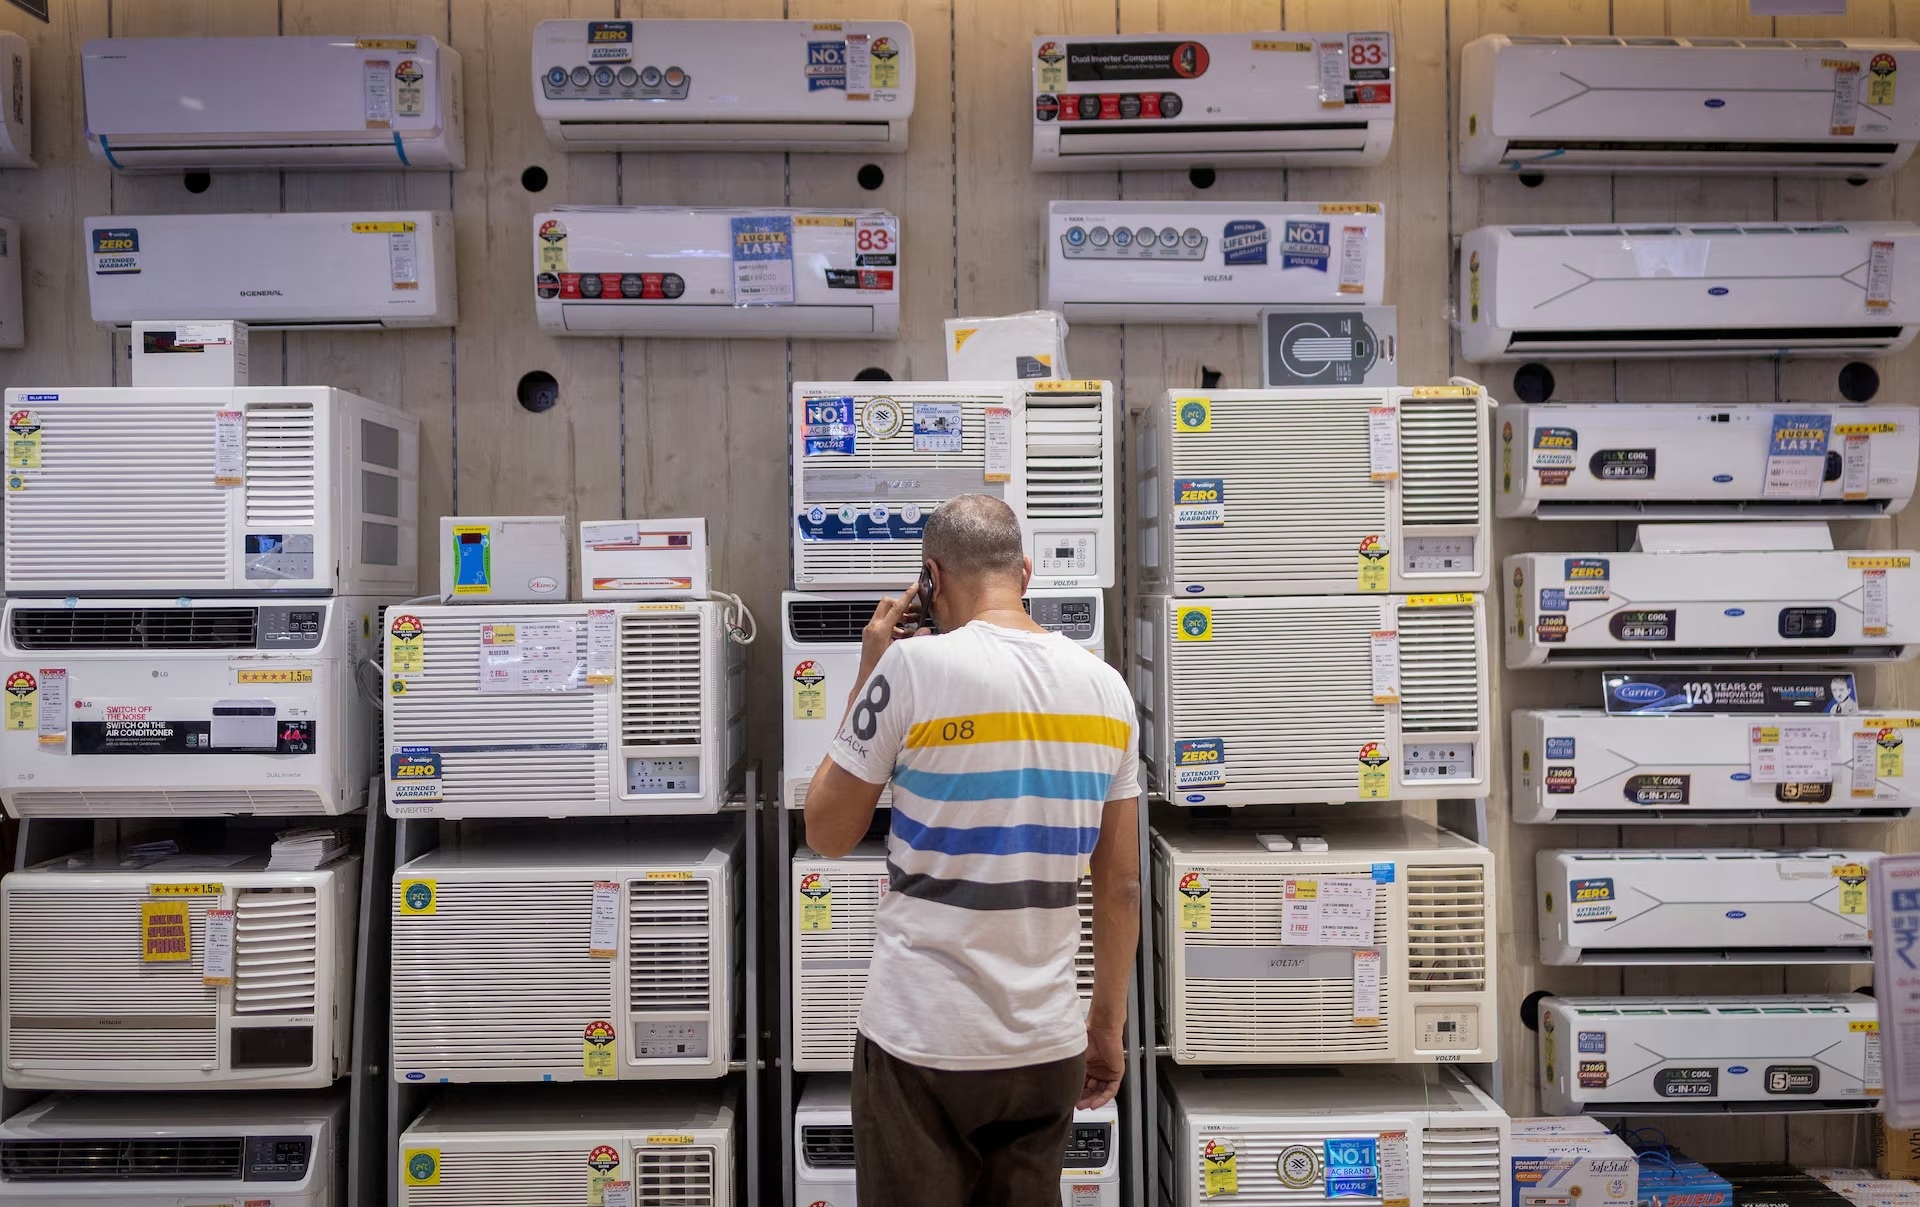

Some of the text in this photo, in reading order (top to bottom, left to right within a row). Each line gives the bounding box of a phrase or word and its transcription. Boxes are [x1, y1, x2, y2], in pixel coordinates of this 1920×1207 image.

[593, 31, 627, 40] ZERO
[1090, 54, 1121, 62] Inverter
[1122, 54, 1170, 63] Compressor
[858, 230, 894, 250] 83%
[1224, 232, 1268, 249] LIFETIME
[1288, 228, 1324, 244] NO.1
[99, 240, 134, 249] ZERO
[744, 242, 782, 254] LAST
[808, 406, 848, 424] NO.1
[822, 426, 849, 434] BRAND
[813, 440, 845, 448] VOLTAS
[1540, 436, 1574, 446] ZERO
[1780, 440, 1818, 450] LAST
[1628, 452, 1648, 460] COOL
[1604, 466, 1634, 476] 6-IN-1
[1180, 490, 1218, 500] ZERO
[1892, 558, 1902, 568] 1.5
[1571, 568, 1604, 578] ZERO
[1648, 613, 1668, 622] COOL
[1624, 626, 1654, 637] 6-IN-1
[290, 671, 302, 682] 1.5
[1621, 682, 1763, 705] Carrier 123 YEARS OF
[1714, 690, 1764, 699] INNOVATION
[852, 674, 890, 740] 8
[942, 720, 975, 742] 08
[1182, 750, 1218, 762] ZERO
[396, 764, 435, 776] ZERO
[1662, 776, 1683, 785] COOL
[1639, 790, 1668, 800] 6-IN-1
[202, 884, 212, 894] 1.5
[1576, 887, 1610, 898] ZERO
[149, 914, 182, 925] ASK FOR
[148, 926, 185, 938] SPECIAL
[147, 938, 186, 954] PRICE
[1270, 958, 1306, 968] VOLTAS
[1580, 1042, 1593, 1050] FIXED
[1691, 1070, 1712, 1078] COOL
[1730, 1066, 1746, 1074] Carrier
[1772, 1074, 1786, 1088] 5
[1668, 1084, 1710, 1094] 6-IN-1 AC
[1330, 1148, 1370, 1164] NO.1
[1590, 1160, 1630, 1174] SafeStab
[1666, 1193, 1724, 1207] SHIELD
